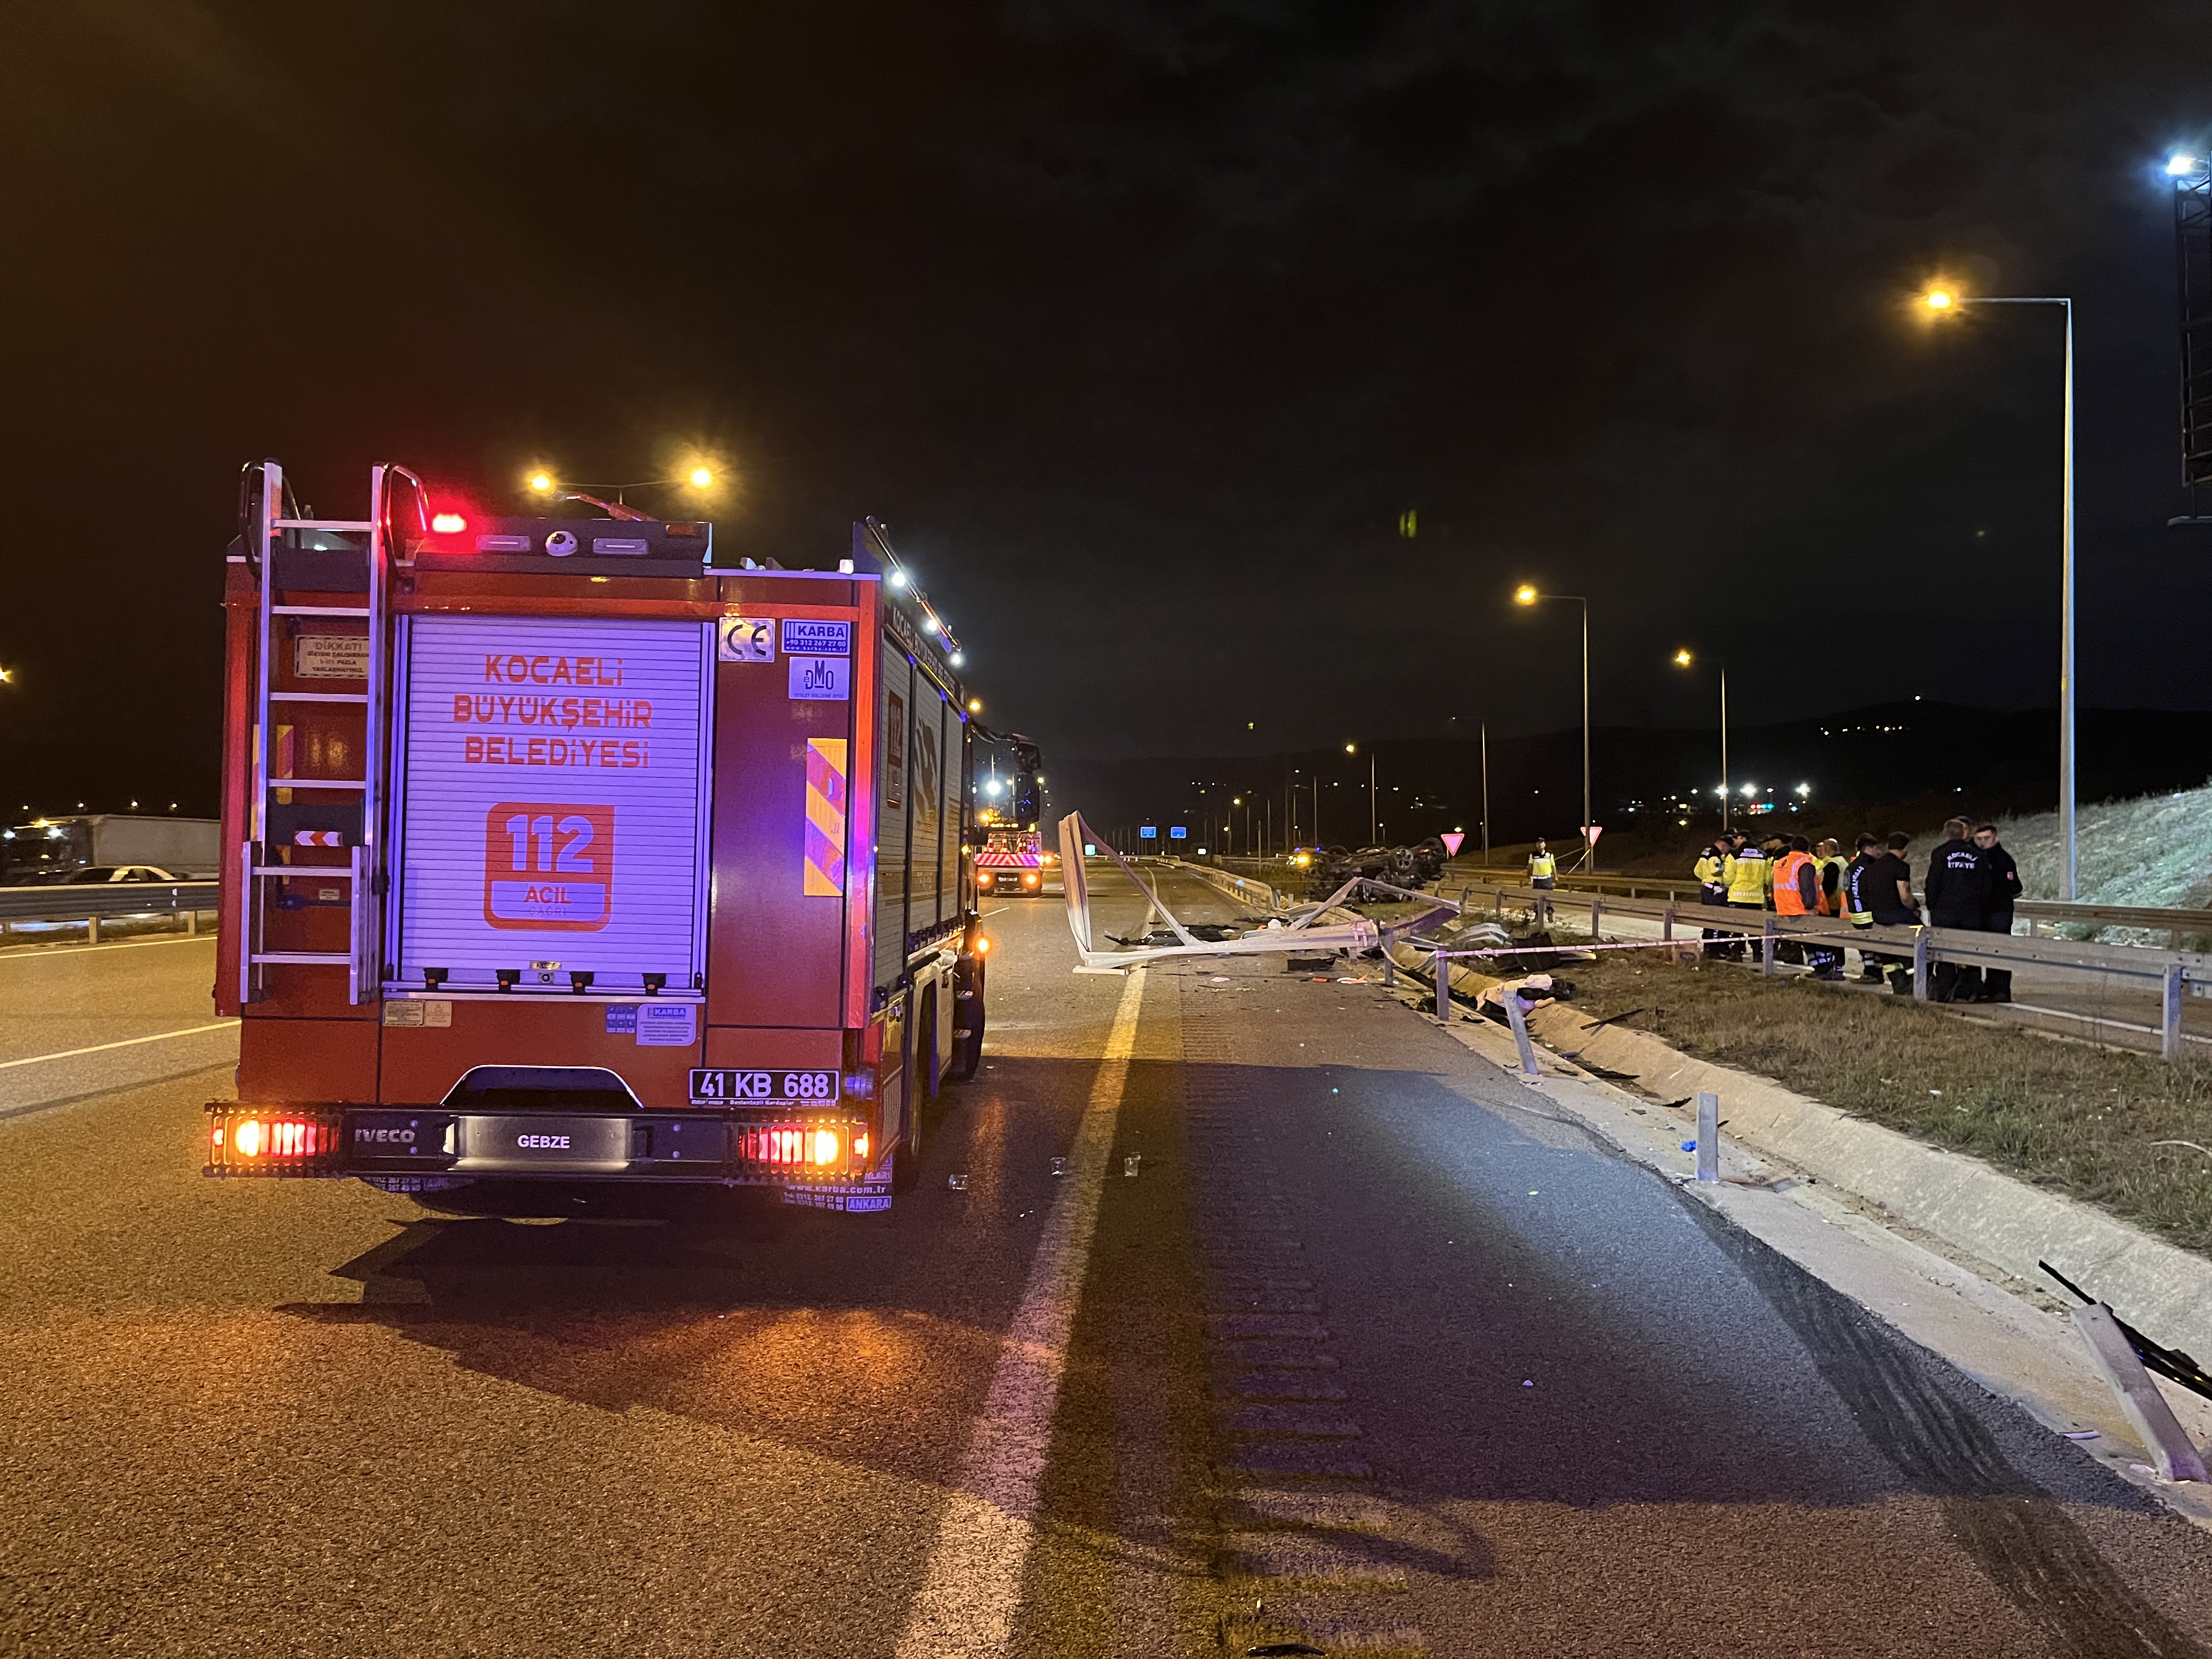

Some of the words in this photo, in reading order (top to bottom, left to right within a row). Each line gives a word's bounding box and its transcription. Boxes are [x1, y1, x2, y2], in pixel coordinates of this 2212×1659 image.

[727, 624, 766, 656] CE
[798, 625, 844, 637] KARBA
[485, 654, 623, 686] KOCAELİ
[804, 660, 834, 690] DMO
[453, 694, 653, 733] BÜYÜKŞEHİR
[465, 736, 649, 769] BELEDİYESİ
[506, 815, 594, 872] 112
[524, 886, 572, 904] ACİL
[701, 1073, 724, 1097] 41
[735, 1073, 772, 1097] KB
[784, 1073, 829, 1097] 688
[355, 1129, 415, 1143] IVECO
[517, 1135, 570, 1149] GEBZE
[850, 1198, 890, 1210] ANKARA
